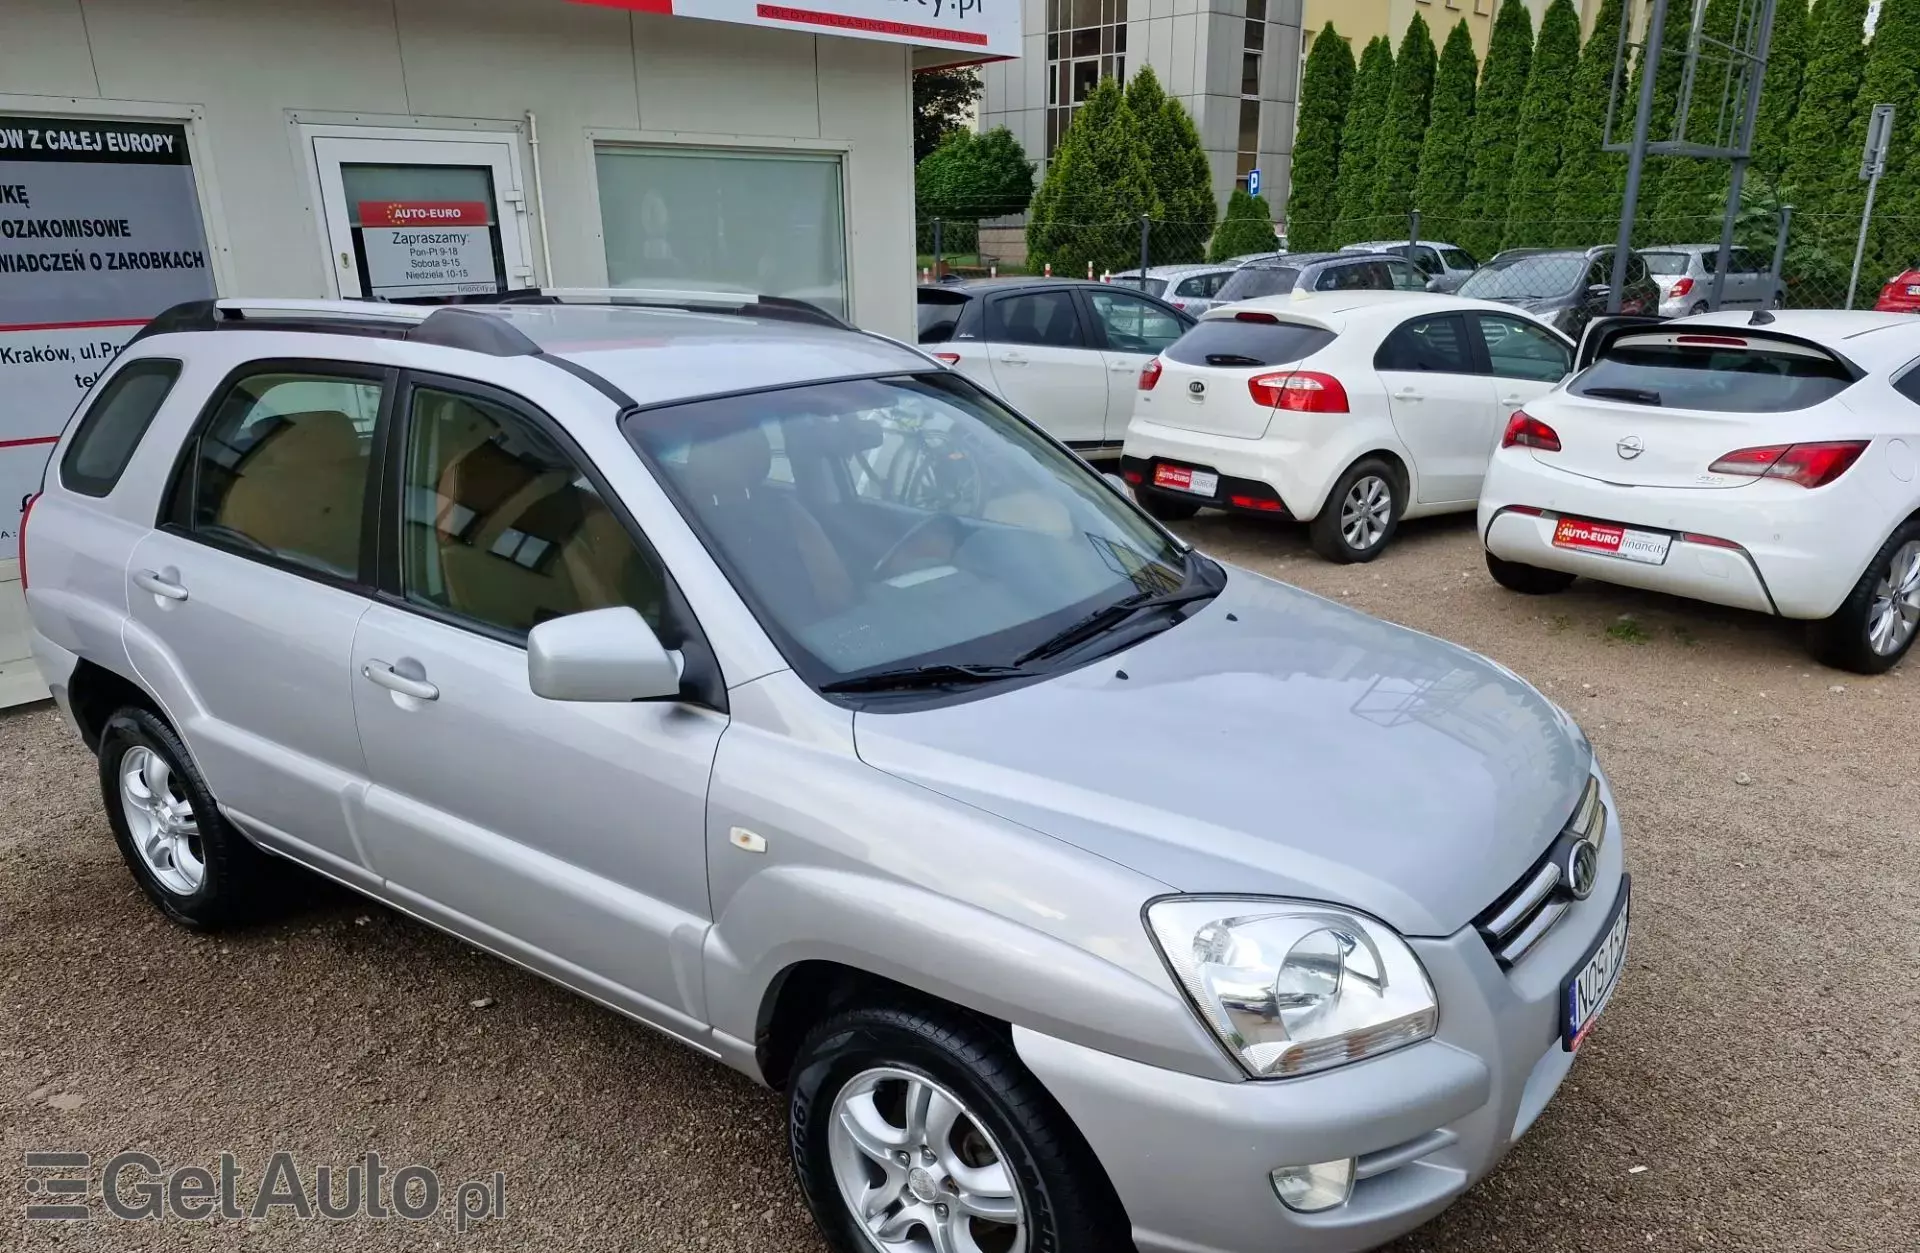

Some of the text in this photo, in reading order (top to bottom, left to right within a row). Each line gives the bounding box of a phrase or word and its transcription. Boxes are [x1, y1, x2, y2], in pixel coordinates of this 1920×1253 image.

[761, 7, 821, 22] KREDYTY
[830, 16, 885, 32] LEASING
[28, 129, 43, 149] Z
[45, 130, 102, 151] CAŁEJ
[106, 132, 173, 153] EUROPY
[0, 185, 30, 208] KĘ
[394, 208, 461, 218] AUTO-EURO
[392, 231, 470, 246] Zapraszamy:
[90, 252, 102, 270] O
[105, 251, 205, 270] ZAROBKACH
[409, 247, 458, 257] Pon-Pt 9-18
[411, 258, 460, 268] Sobota 9-15
[406, 269, 468, 279] Niedziela 10-15
[0, 344, 76, 364] Kraków,
[1562, 527, 1619, 545] AUTO-EURO
[1578, 948, 1604, 1023] NOS
